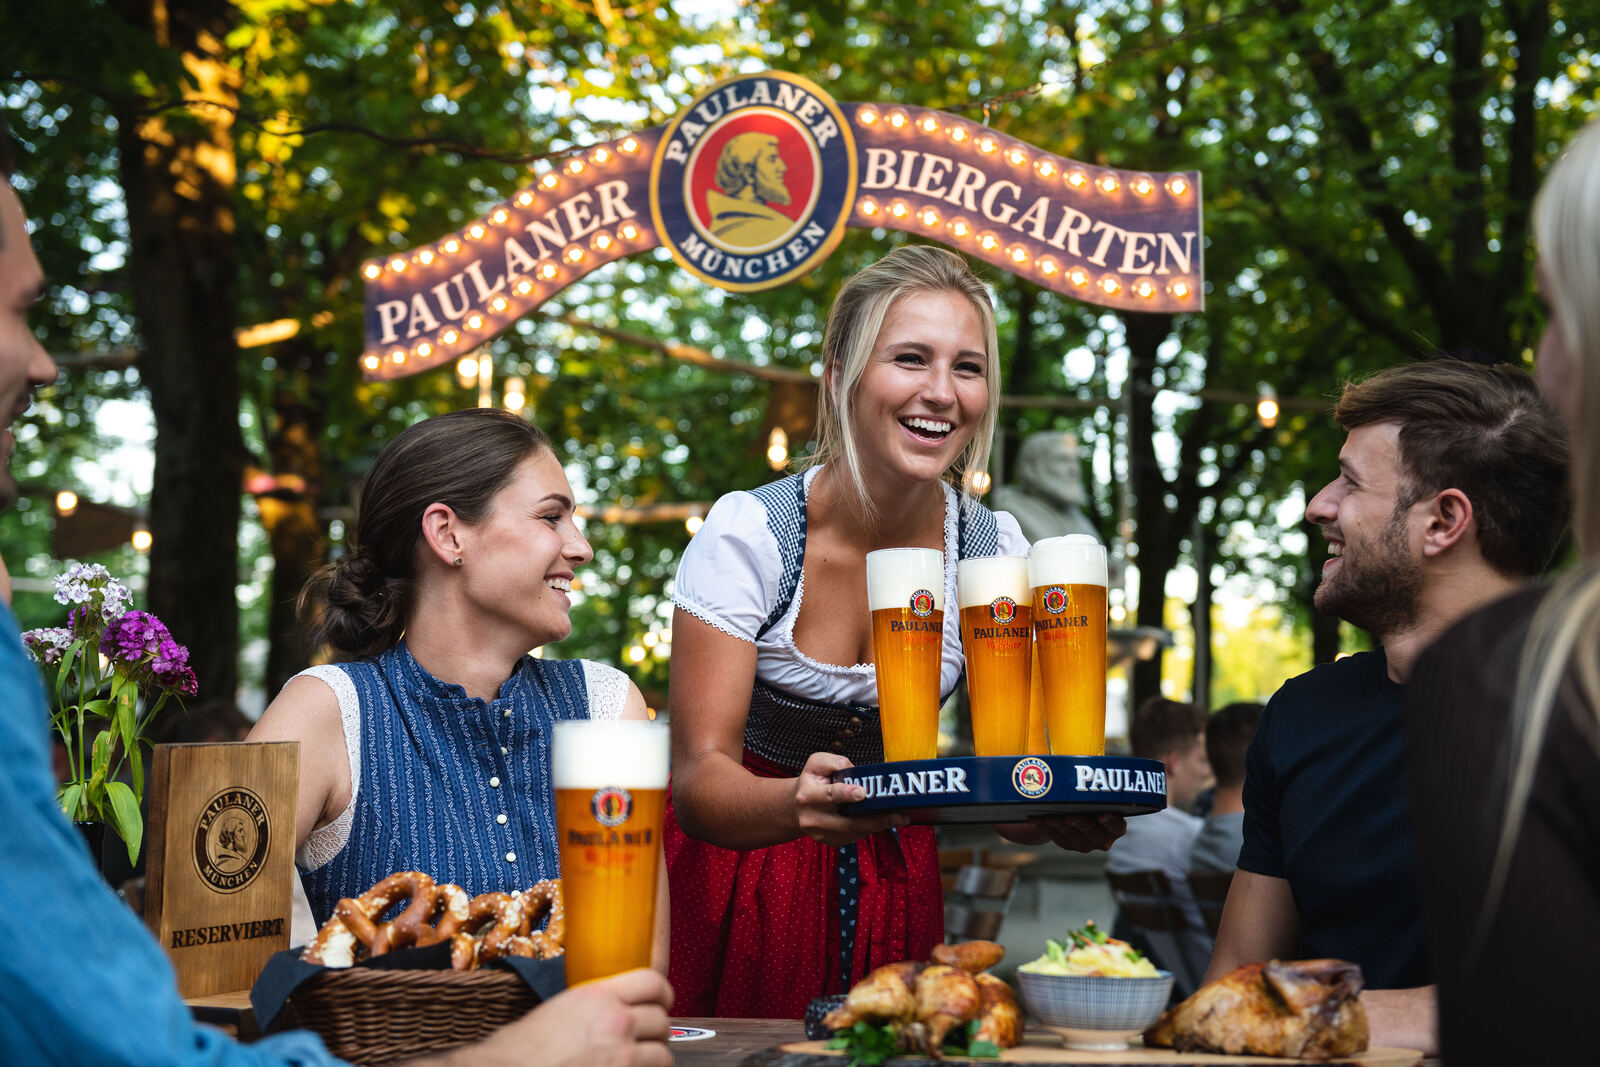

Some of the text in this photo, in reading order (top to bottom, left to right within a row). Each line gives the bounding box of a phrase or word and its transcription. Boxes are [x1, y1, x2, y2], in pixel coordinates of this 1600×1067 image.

[665, 80, 838, 165] PAULANER
[376, 148, 1196, 344] PAULANER BIERGARTEN
[680, 220, 826, 279] MÜNCHEN
[200, 792, 265, 831] PAULANER
[202, 860, 259, 888] MÜNCHEN
[171, 918, 285, 949] RESERVIERT
